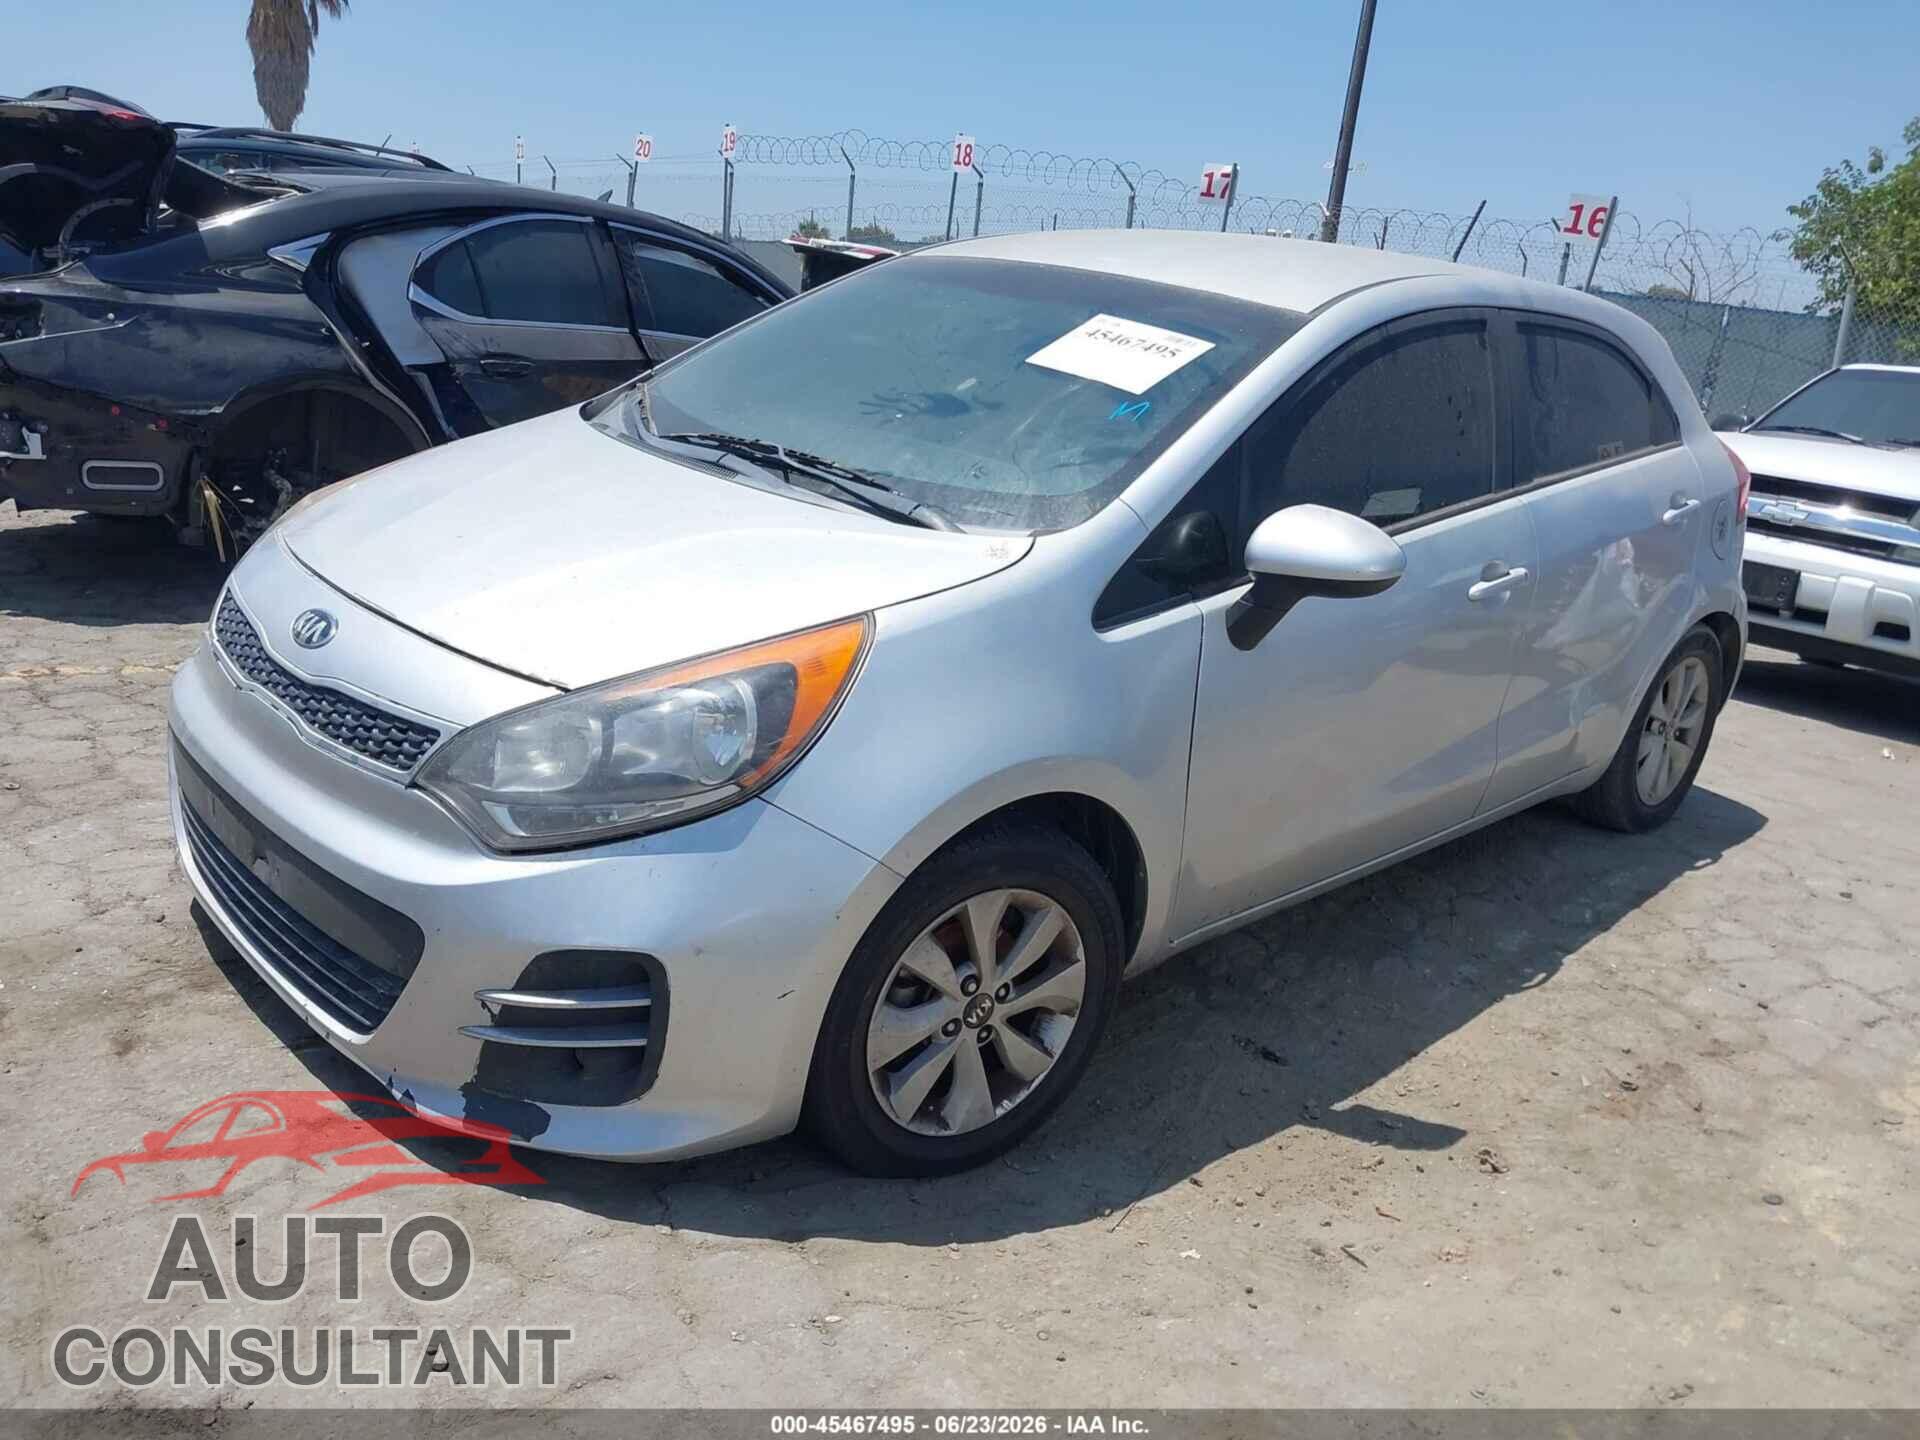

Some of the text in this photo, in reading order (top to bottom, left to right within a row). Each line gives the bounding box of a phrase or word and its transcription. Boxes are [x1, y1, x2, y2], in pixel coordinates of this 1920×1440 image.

[635, 139, 651, 158] 20
[723, 131, 736, 152] 19
[954, 143, 973, 167] 18
[1200, 171, 1231, 199] 17
[1563, 204, 1608, 238] 16
[1086, 329, 1182, 358] 45467495
